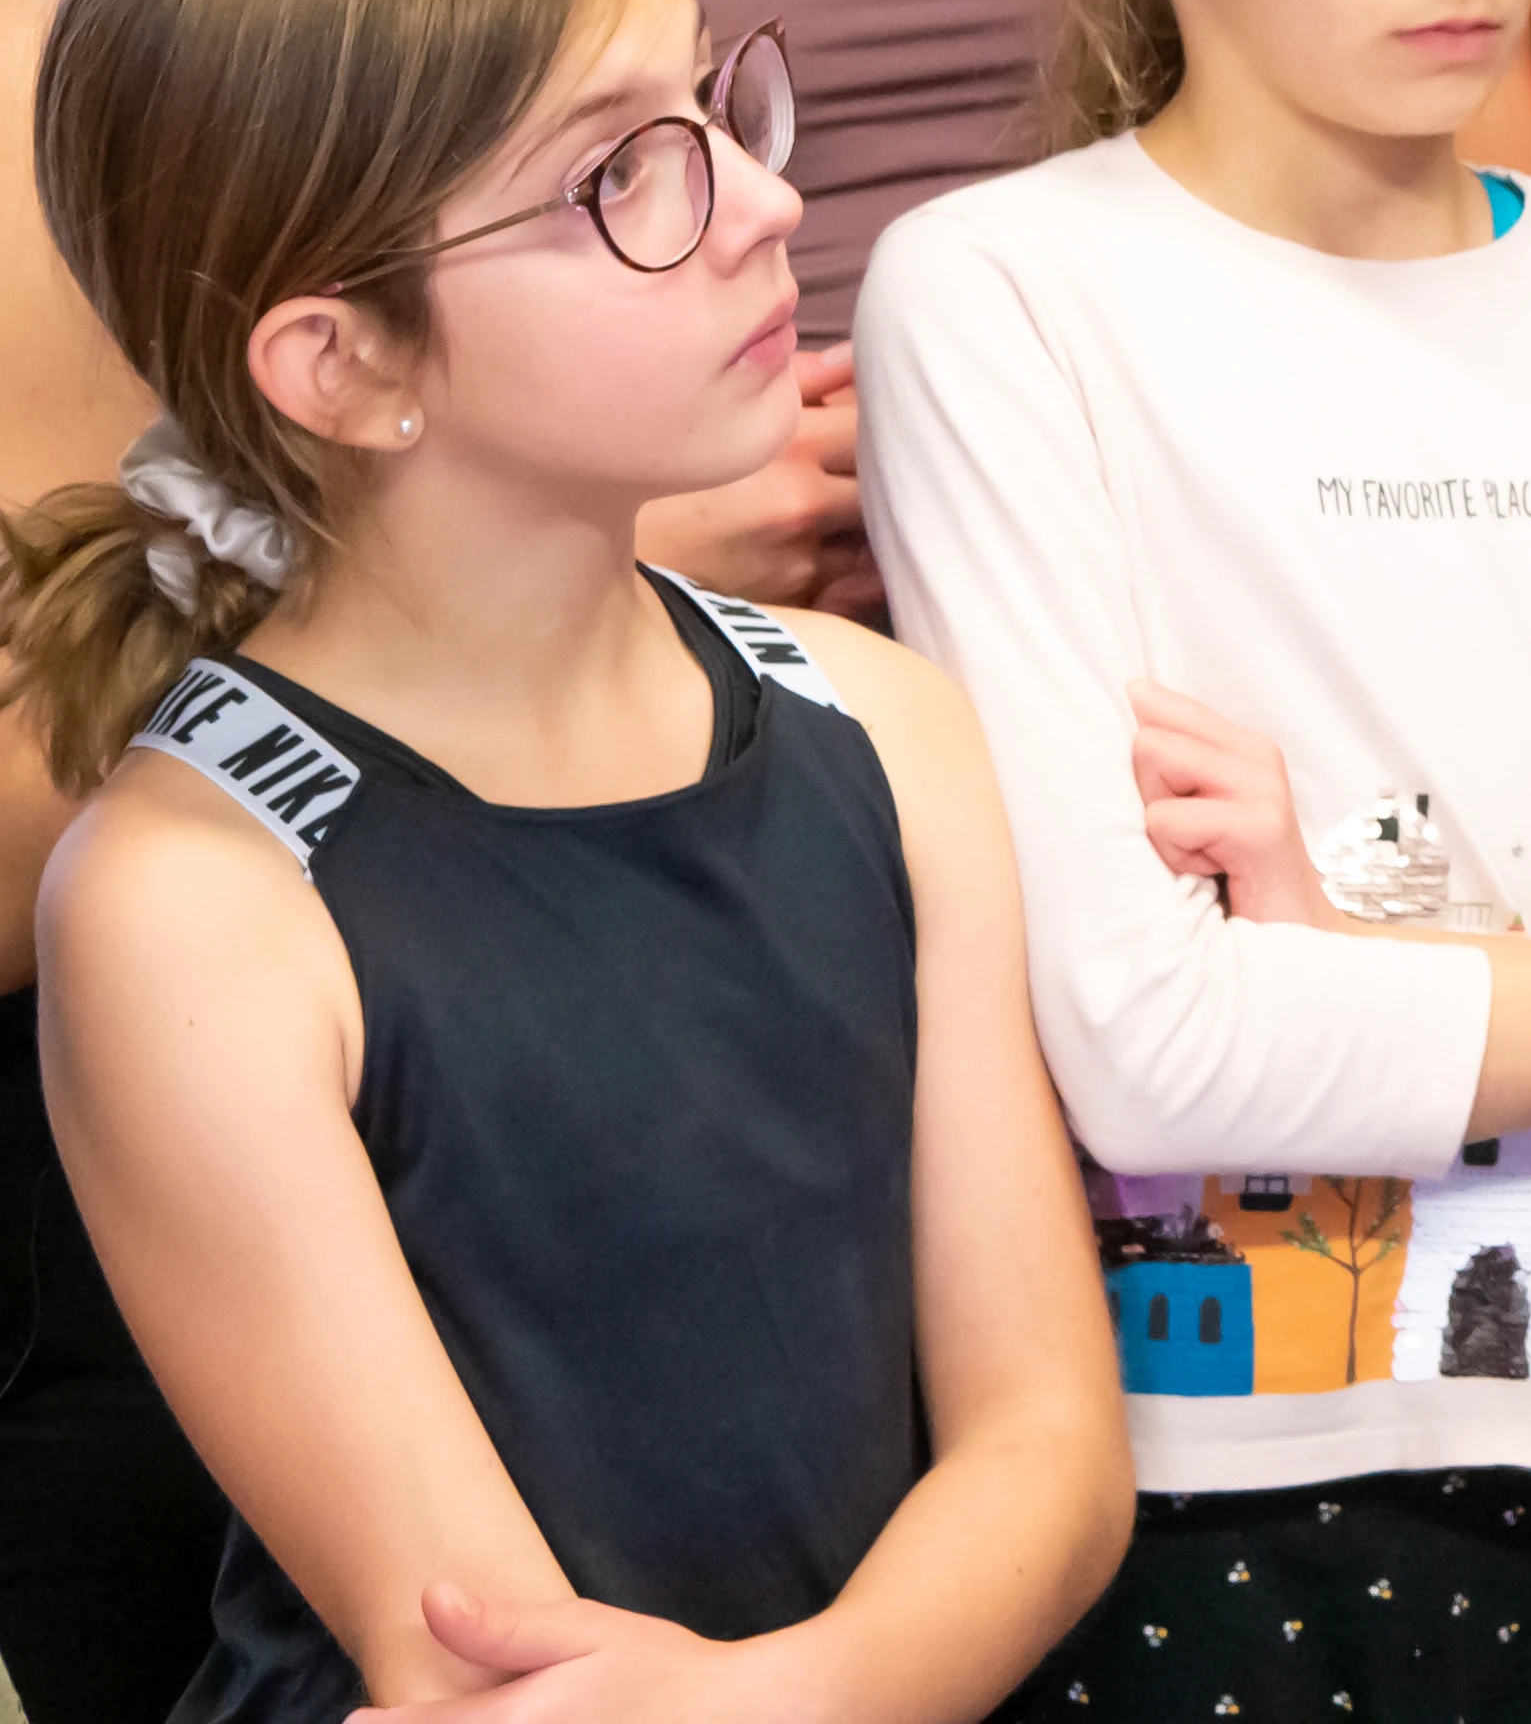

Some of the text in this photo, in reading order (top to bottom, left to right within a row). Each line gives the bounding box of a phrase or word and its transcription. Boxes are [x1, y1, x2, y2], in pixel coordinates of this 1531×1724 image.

[1317, 476, 1352, 516] MY
[1362, 478, 1477, 519] FAVORITE
[704, 598, 809, 665] NIK
[144, 668, 249, 744] IKE
